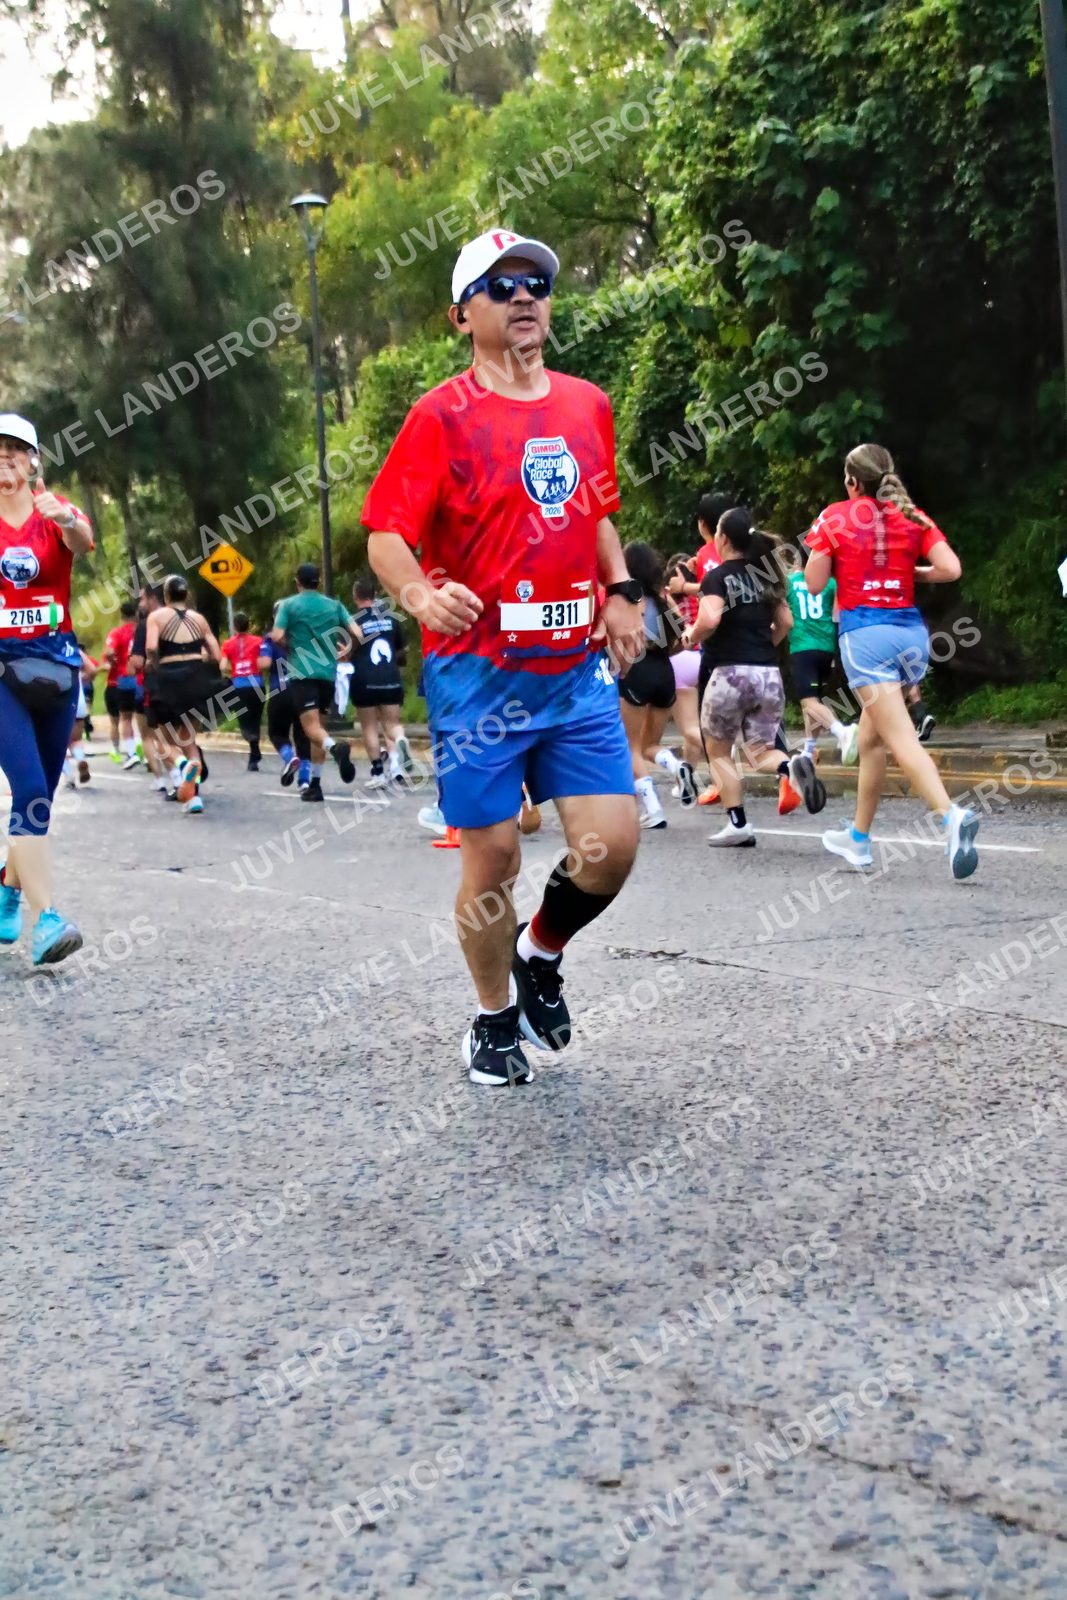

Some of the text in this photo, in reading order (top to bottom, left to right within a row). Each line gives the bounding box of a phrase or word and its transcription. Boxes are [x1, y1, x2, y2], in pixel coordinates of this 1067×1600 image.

[531, 444, 561, 454] BIMBO
[533, 457, 563, 470] Global
[530, 467, 553, 480] Race
[796, 591, 823, 619] 18
[10, 609, 42, 625] 2764
[542, 602, 578, 627] 3311
